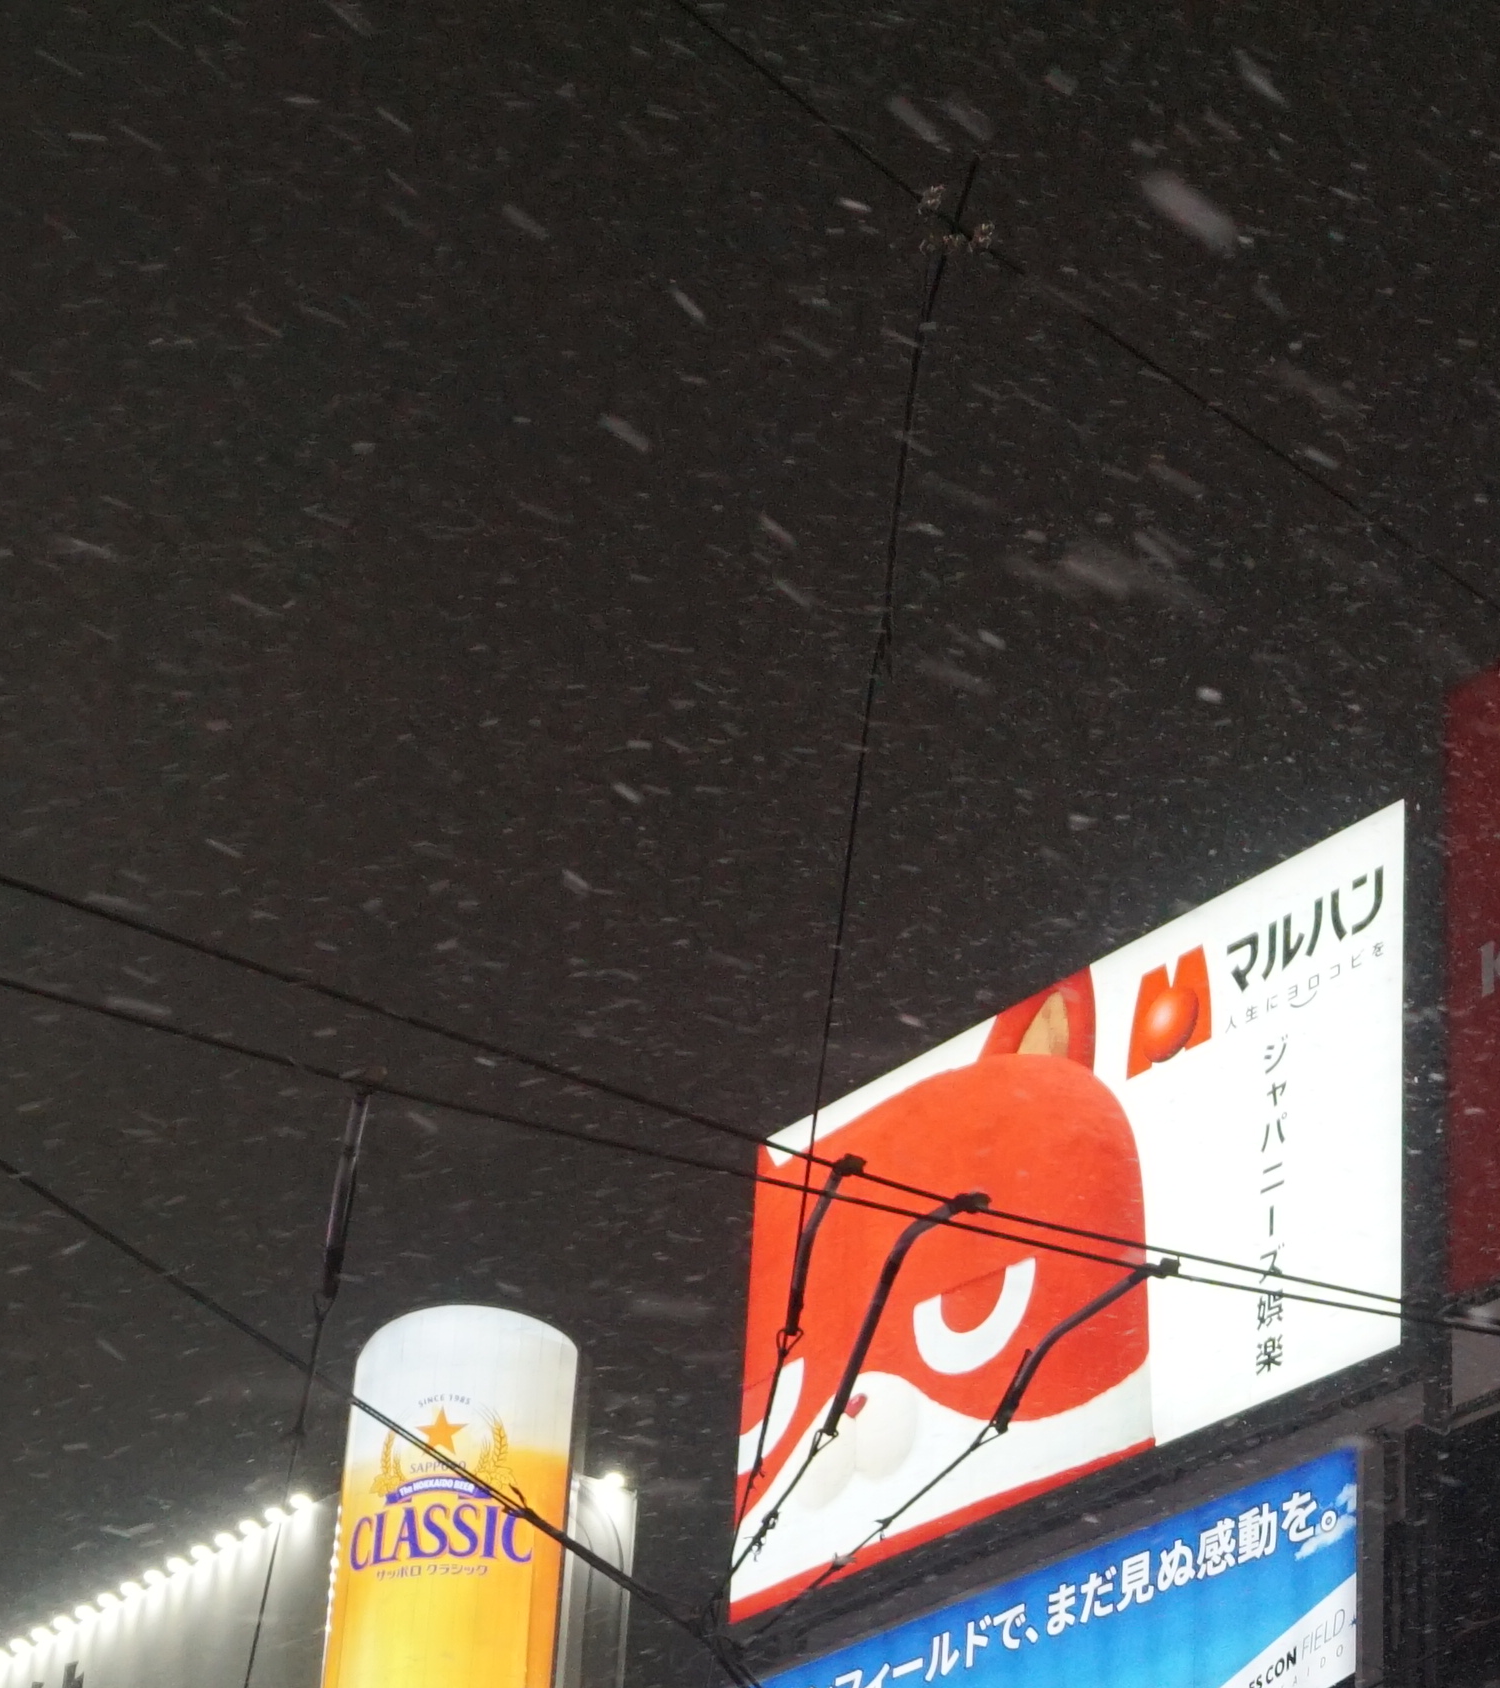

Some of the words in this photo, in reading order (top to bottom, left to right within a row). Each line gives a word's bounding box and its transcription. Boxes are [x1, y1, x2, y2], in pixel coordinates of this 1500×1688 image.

[1226, 865, 1384, 992] マルハン
[1224, 940, 1386, 1034] 人生にヨロコビを
[1256, 1034, 1288, 1377] ジャパニーズ娯楽
[351, 1502, 532, 1571] CLASSIC
[376, 1565, 421, 1581] サッポロ
[426, 1563, 488, 1577] クラシック
[1266, 1647, 1298, 1686] CON
[1300, 1608, 1346, 1659] FIELD
